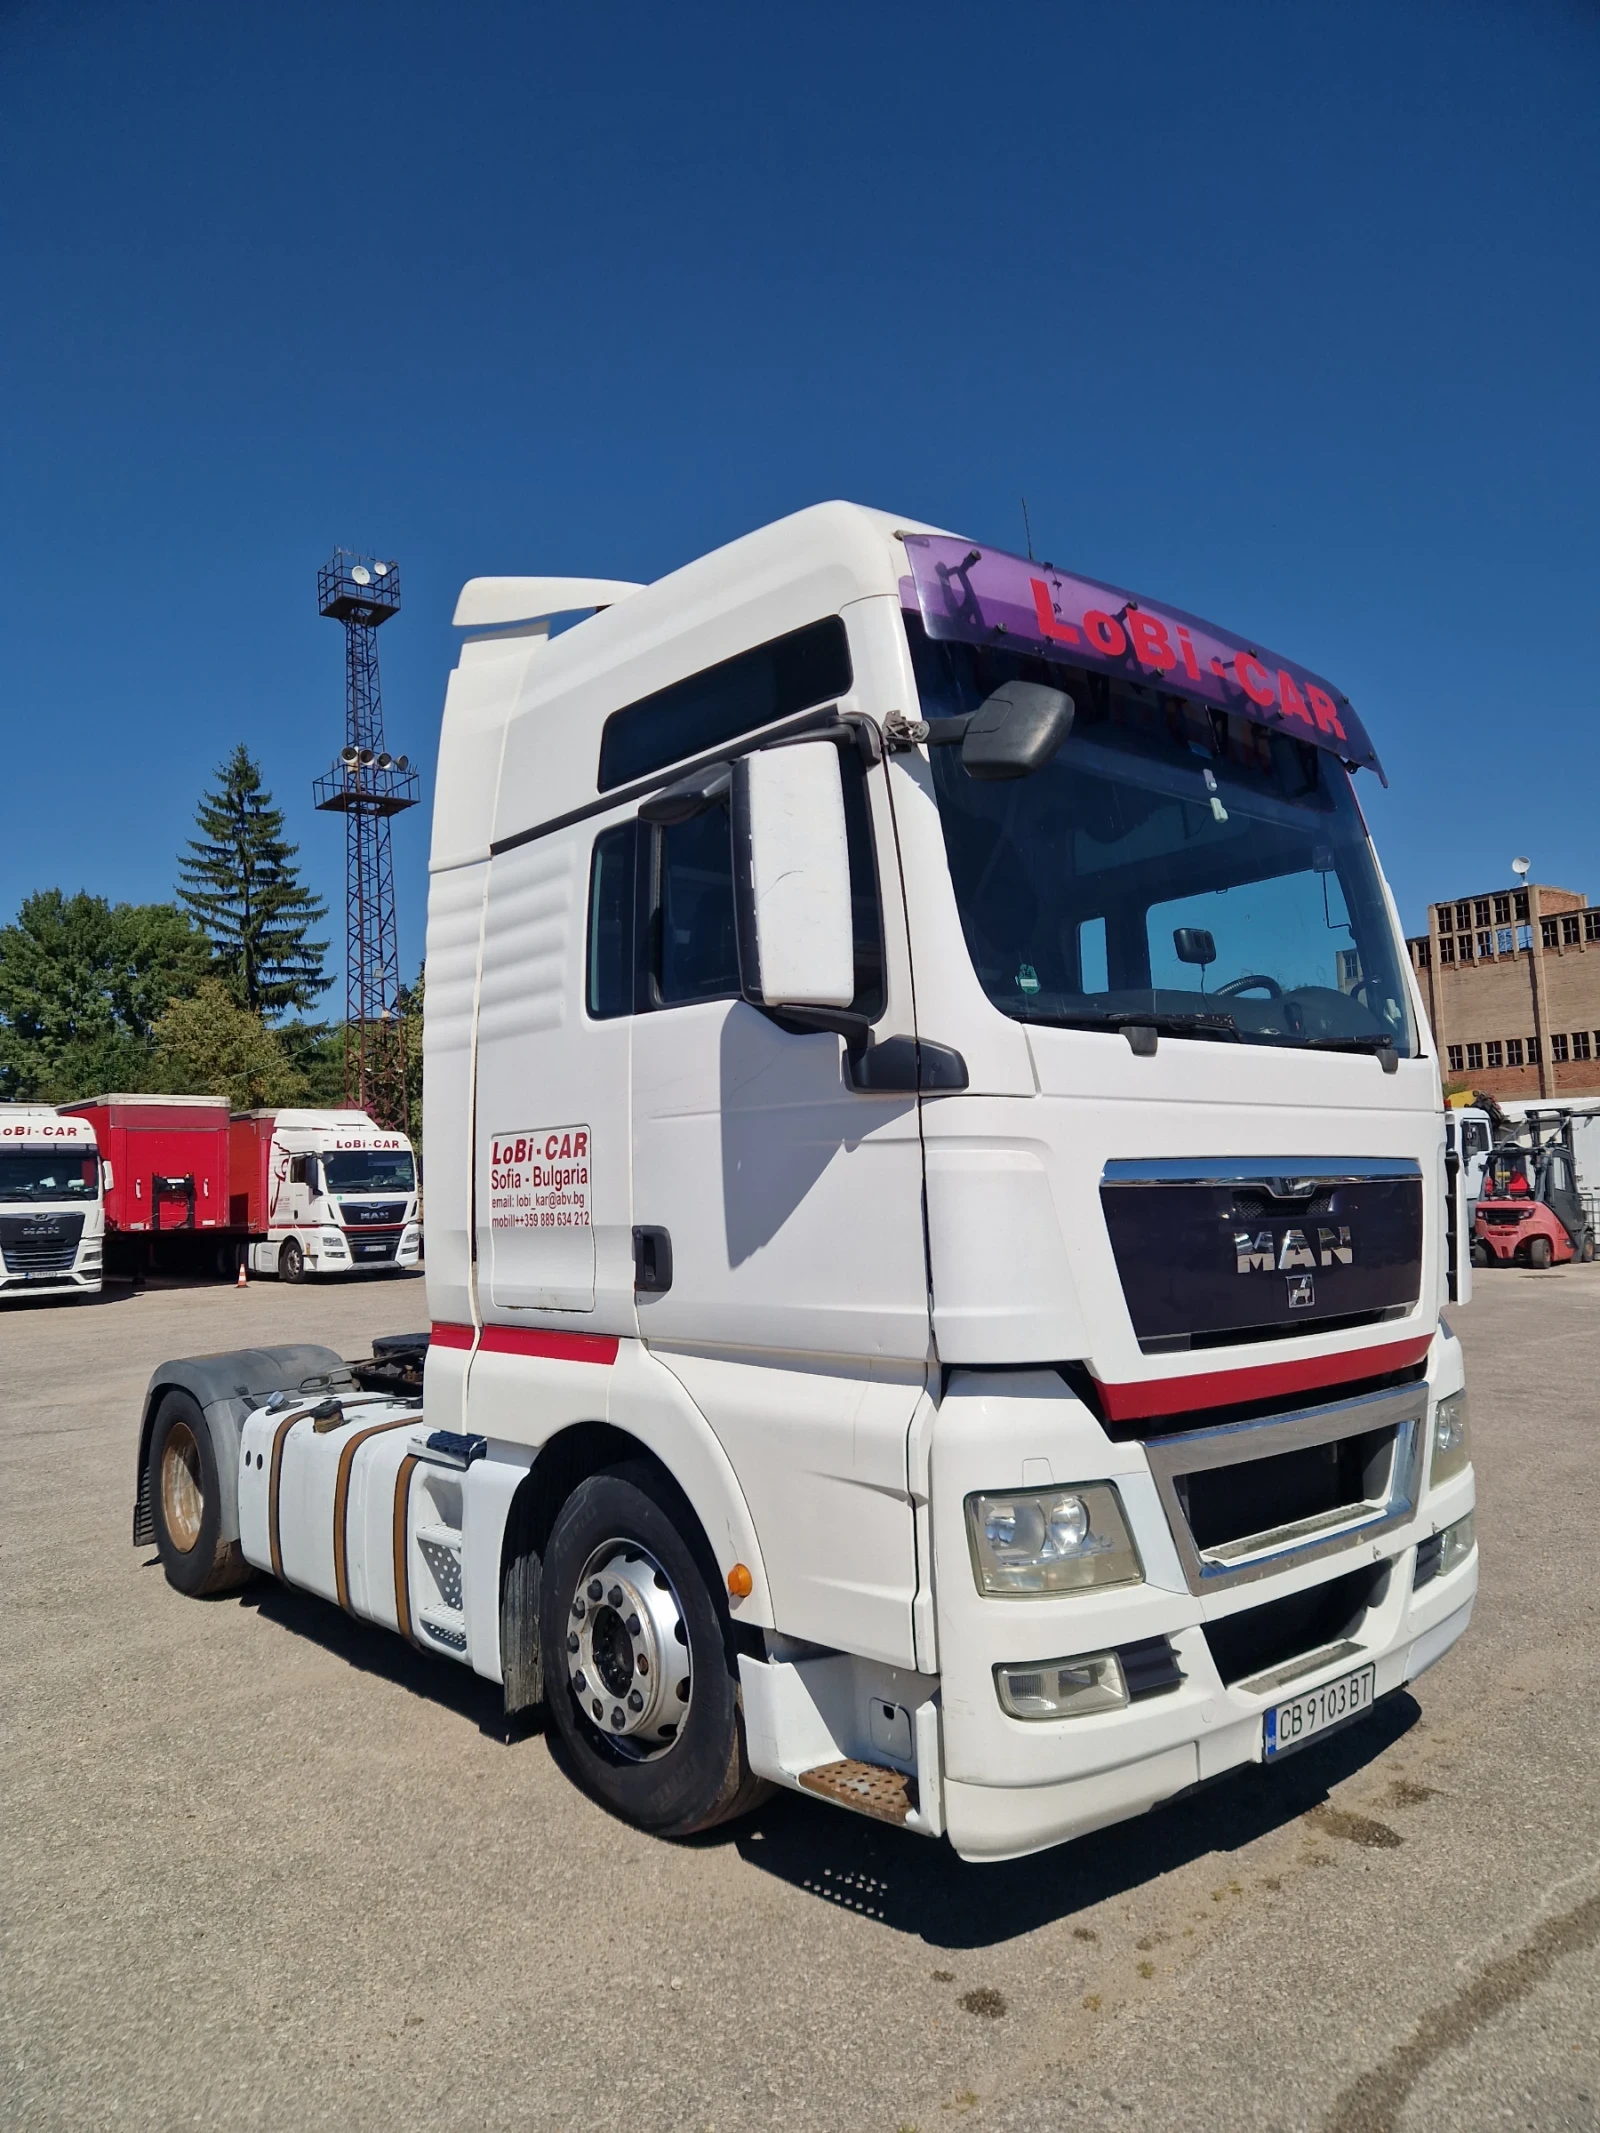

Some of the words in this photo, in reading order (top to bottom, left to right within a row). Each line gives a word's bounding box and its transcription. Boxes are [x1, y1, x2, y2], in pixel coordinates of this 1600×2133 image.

[0, 1126, 77, 1136] oBi-CAR
[491, 1168, 521, 1190] Sofia
[533, 1162, 588, 1192] Bulgaria
[492, 1194, 514, 1208] email:
[540, 1212, 555, 1227] 889
[557, 1211, 572, 1226] 634
[574, 1211, 590, 1226] 212
[1234, 1226, 1353, 1273] MAN
